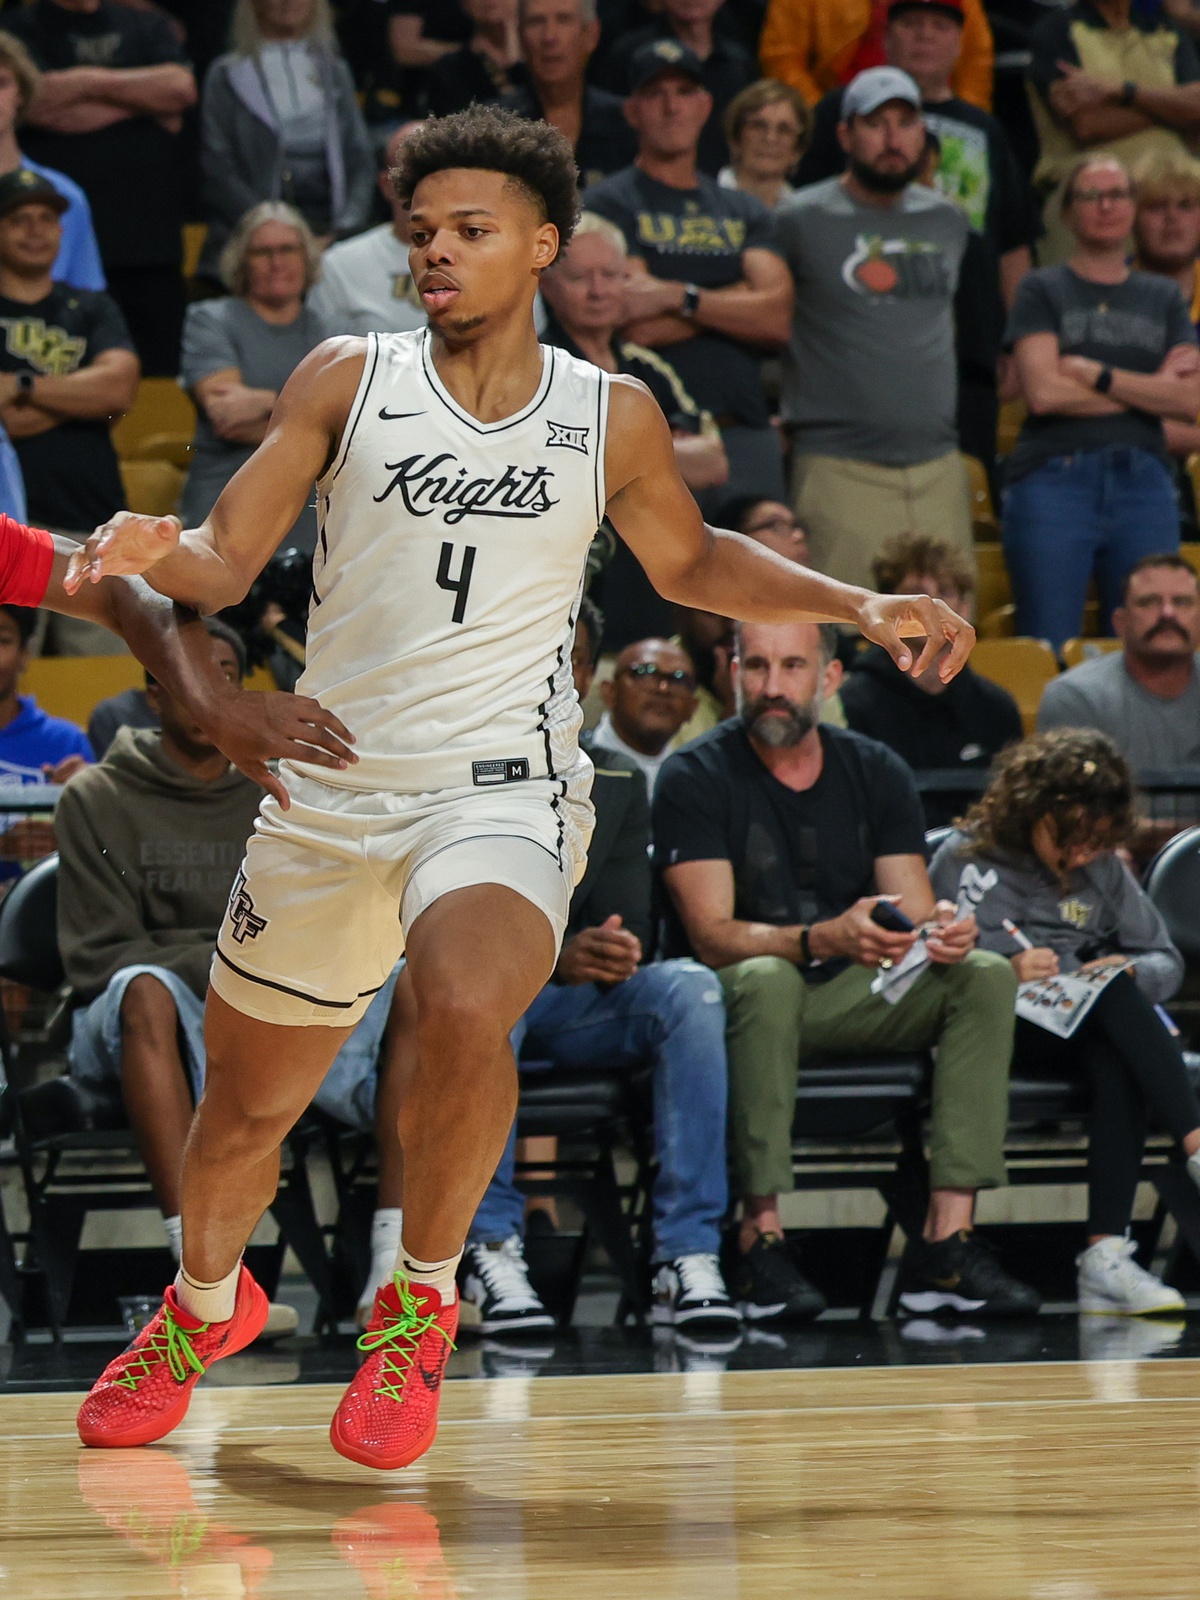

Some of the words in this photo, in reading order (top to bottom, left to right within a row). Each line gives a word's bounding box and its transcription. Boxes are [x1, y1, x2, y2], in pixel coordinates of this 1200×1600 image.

[372, 453, 561, 525] Knights
[435, 541, 477, 624] 4
[511, 765, 522, 777] M
[140, 840, 237, 866] ESSENTI
